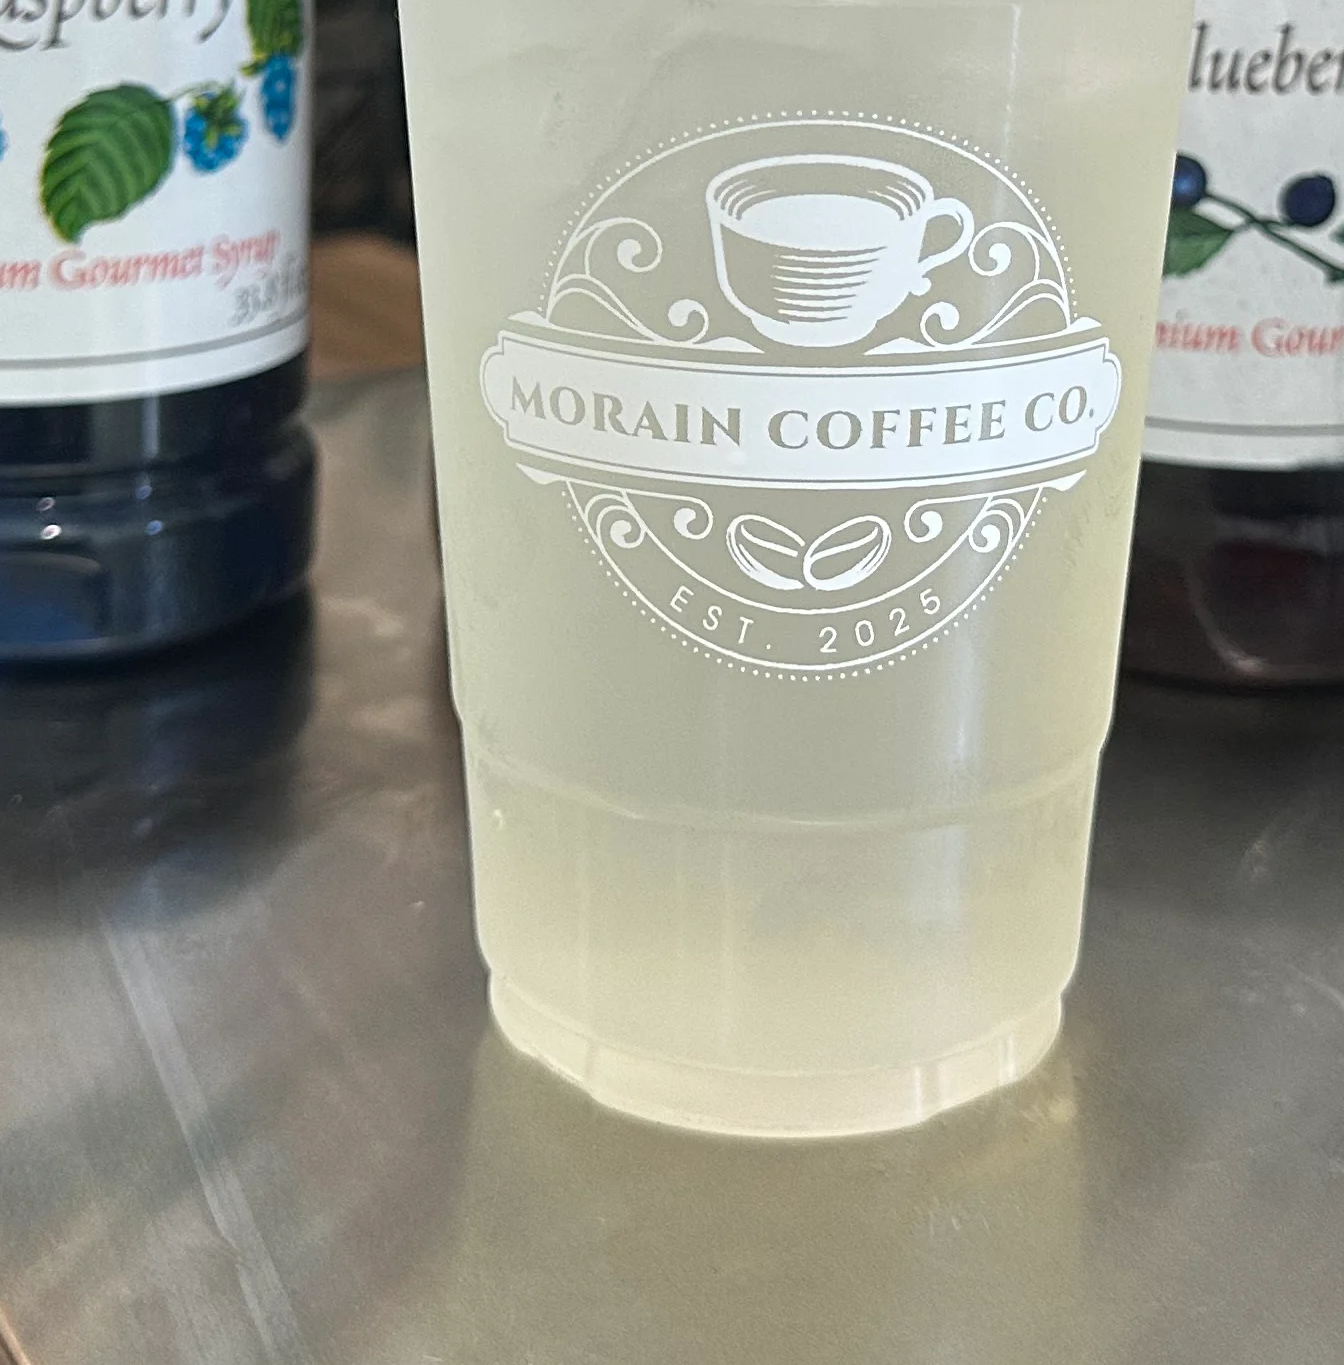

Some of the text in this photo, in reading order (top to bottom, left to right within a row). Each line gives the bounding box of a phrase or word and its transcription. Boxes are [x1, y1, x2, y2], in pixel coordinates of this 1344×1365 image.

[50, 242, 203, 290] Gourmet
[510, 377, 1095, 449] MORAIN COFFEE CO.
[669, 585, 942, 652] EST. 2025
